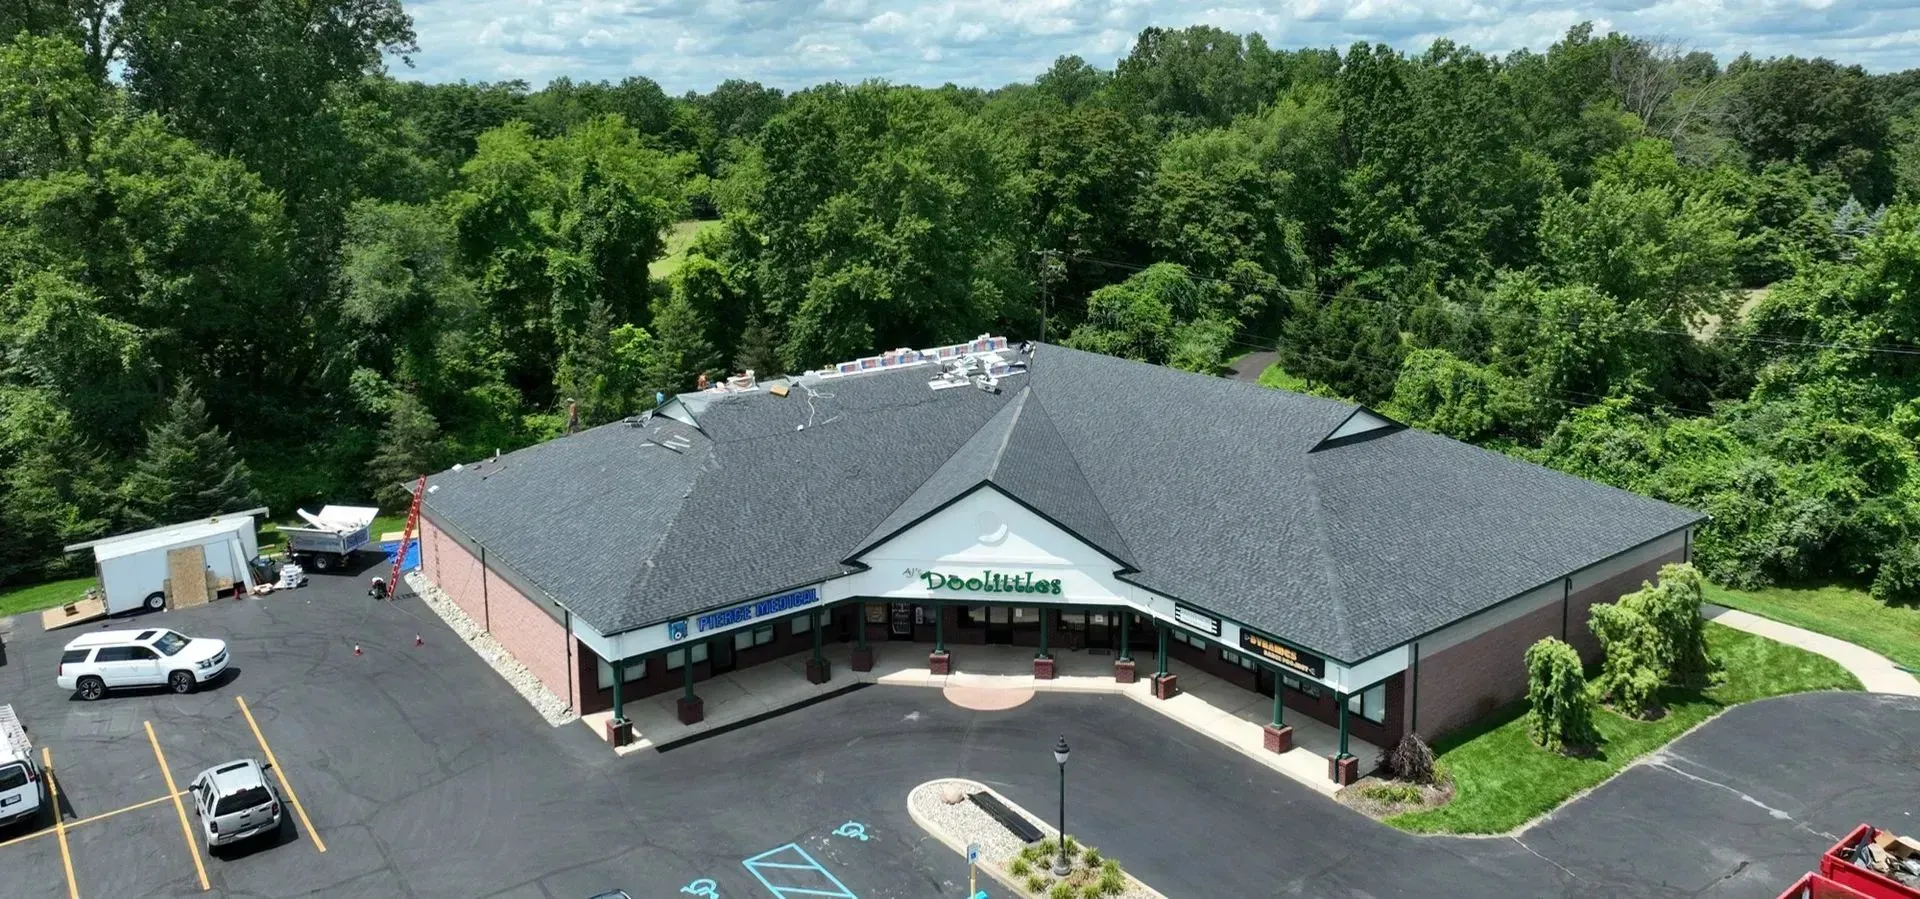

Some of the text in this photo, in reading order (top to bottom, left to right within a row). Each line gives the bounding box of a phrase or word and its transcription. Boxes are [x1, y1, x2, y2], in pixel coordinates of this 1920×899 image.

[920, 570, 1061, 595] Doolittles
[697, 588, 819, 632] PIERCE MEDICAL
